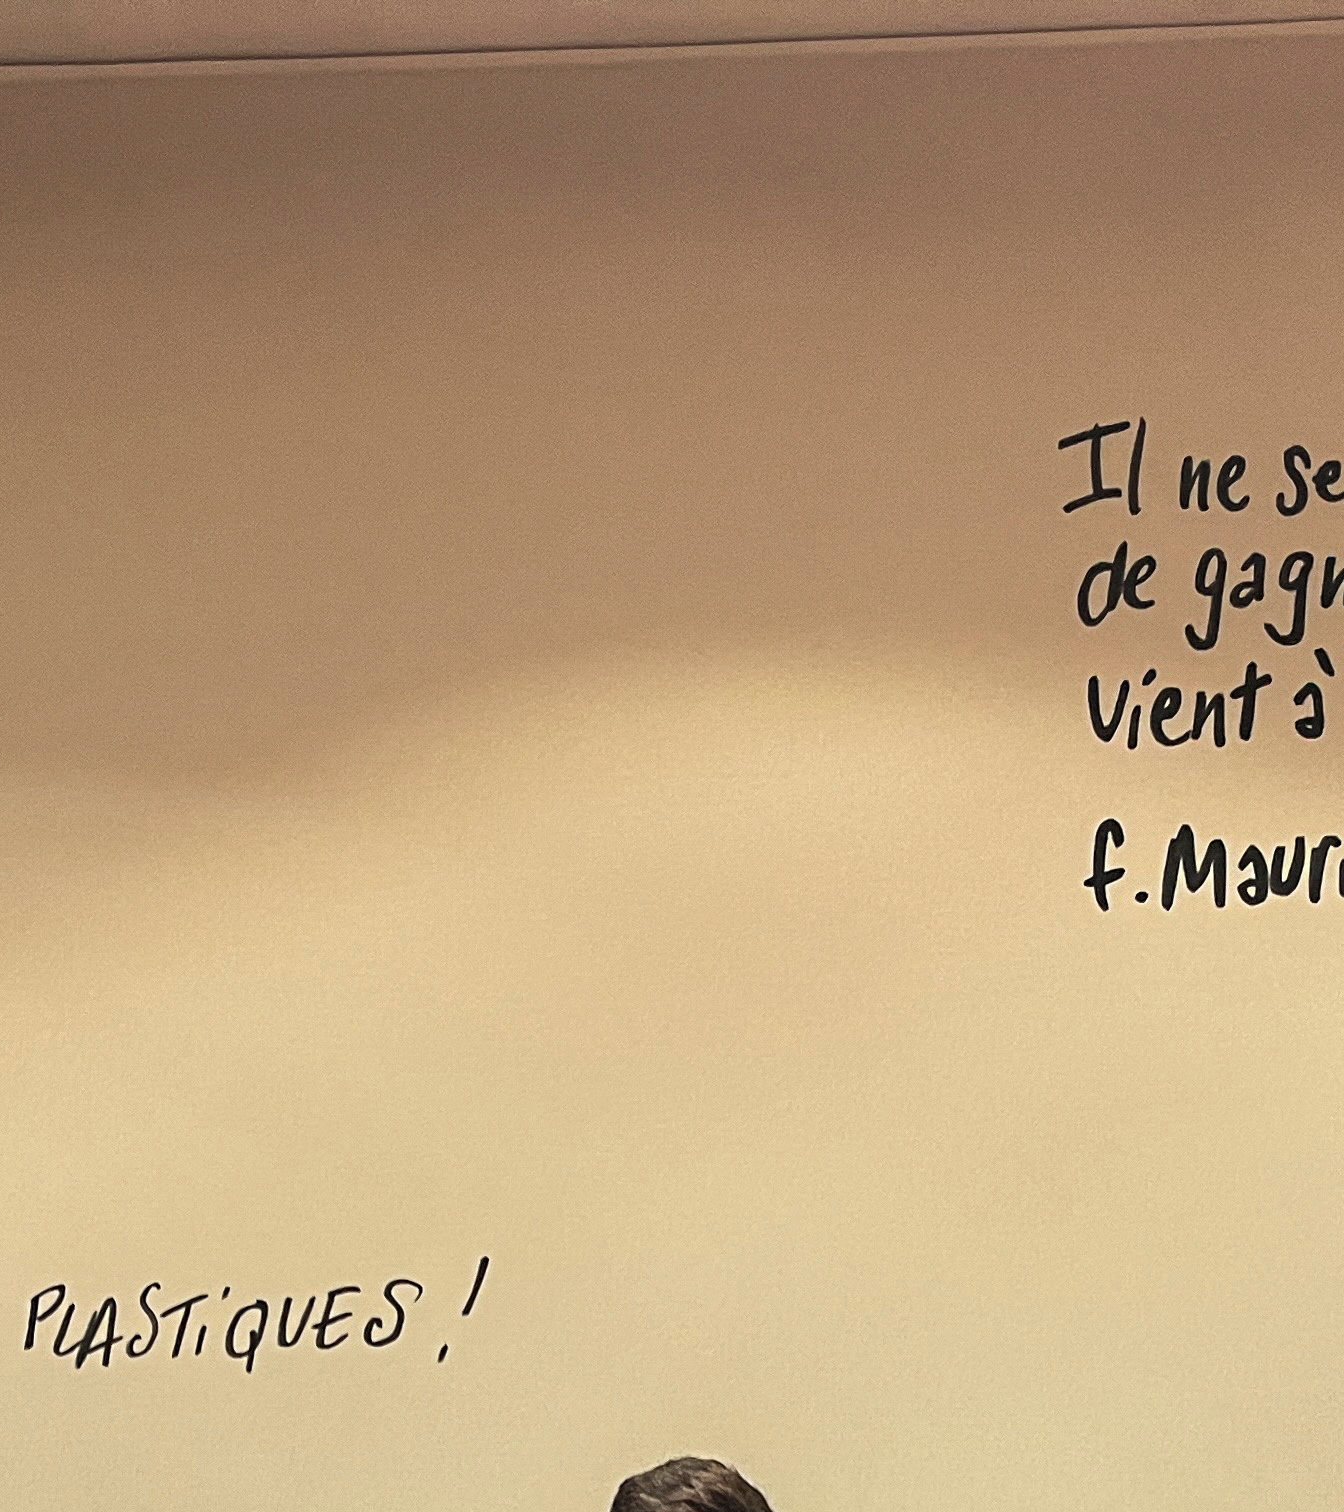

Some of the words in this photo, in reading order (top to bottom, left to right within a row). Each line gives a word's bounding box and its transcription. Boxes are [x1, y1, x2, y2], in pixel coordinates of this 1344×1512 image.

[1058, 416, 1146, 513] Il
[1179, 451, 1250, 513] ne
[1077, 543, 1157, 626] de
[1293, 647, 1336, 743] à
